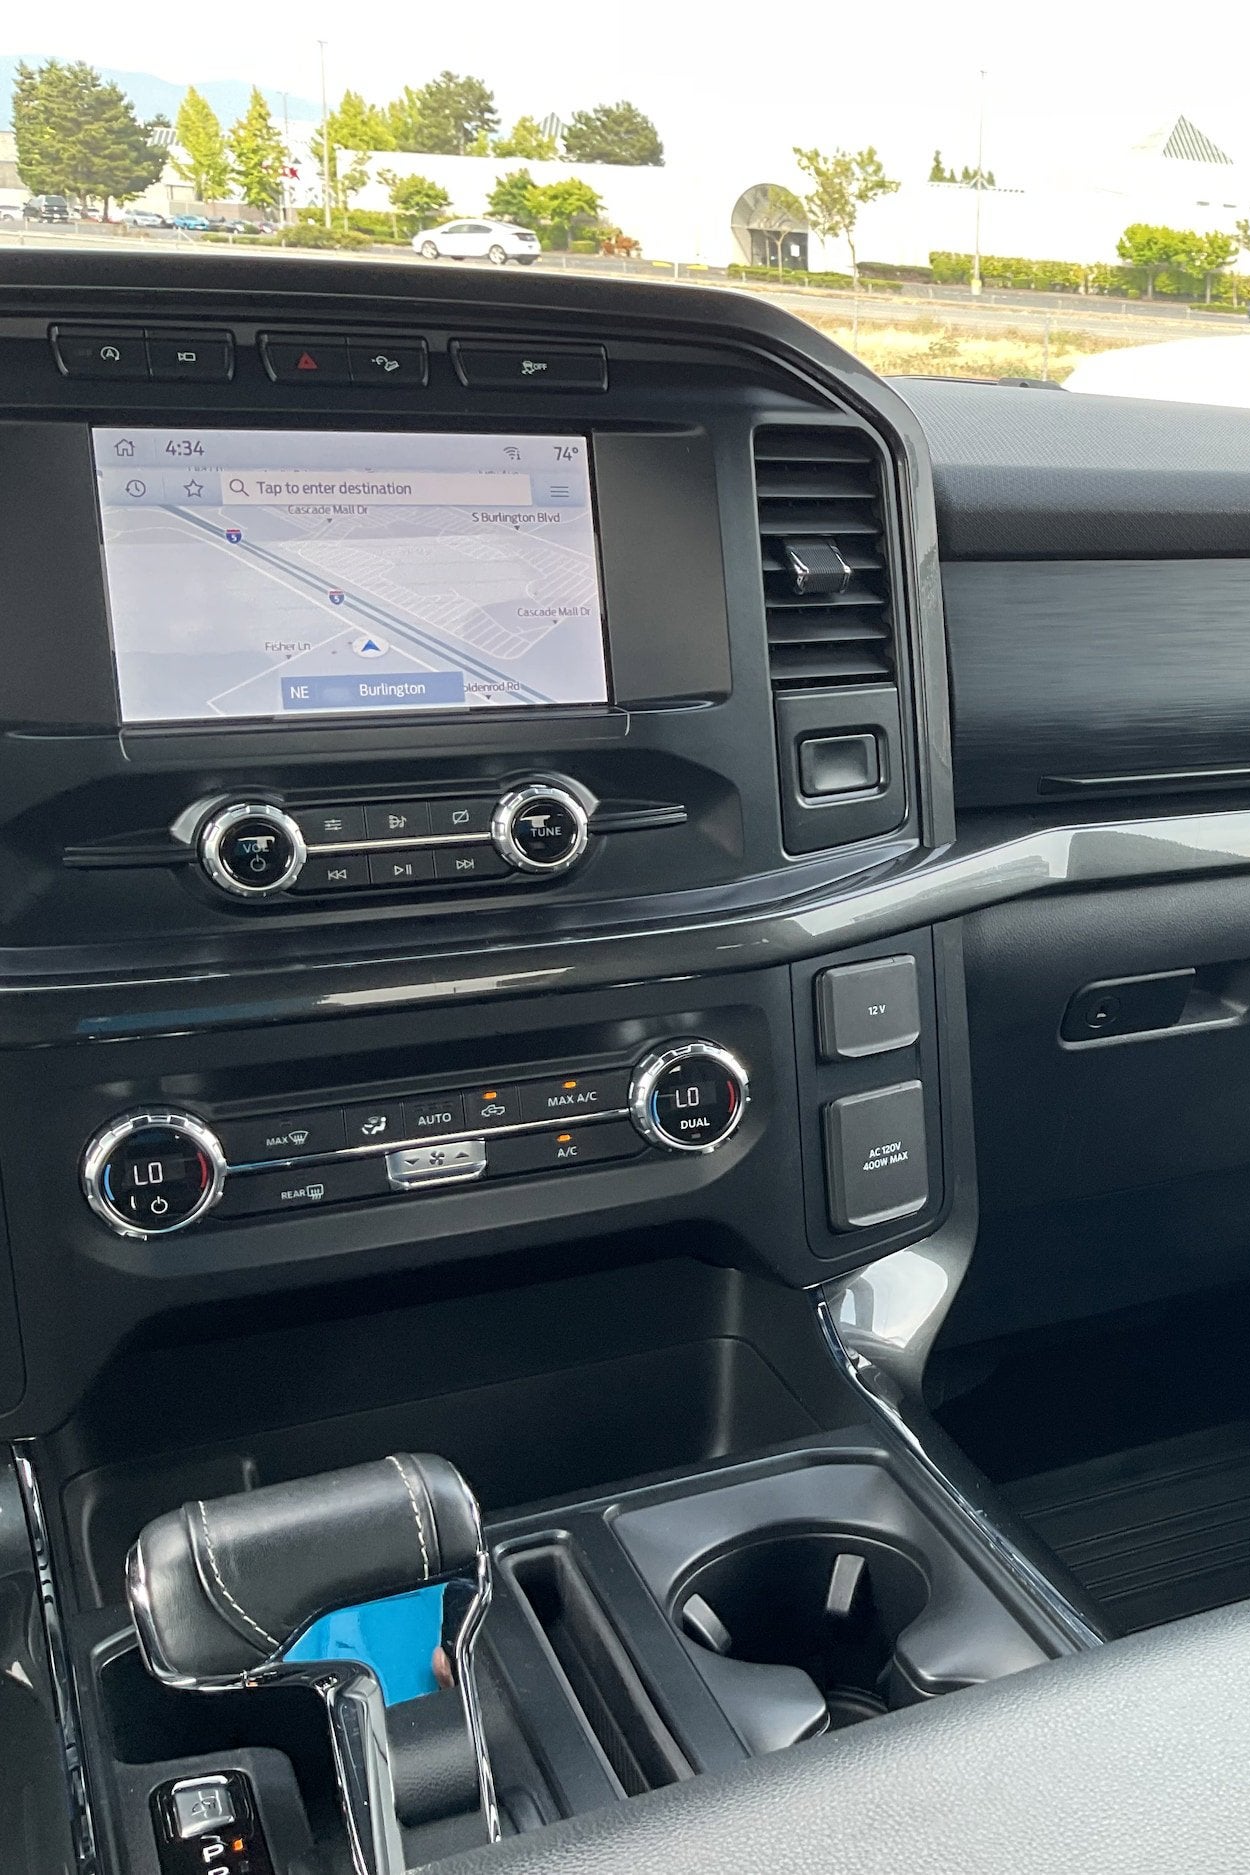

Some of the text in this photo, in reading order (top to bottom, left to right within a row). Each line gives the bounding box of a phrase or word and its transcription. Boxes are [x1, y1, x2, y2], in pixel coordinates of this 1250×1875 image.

[165, 440, 205, 457] 4:34
[553, 446, 580, 462] 74°
[256, 480, 412, 496] Tap to enter destination
[288, 505, 368, 515] Cascade Mall Dr
[472, 513, 561, 525] S Burlington Blvd
[517, 606, 591, 617] Cascade Mall Dr
[264, 641, 311, 651] Fisher Ln
[290, 682, 426, 699] NE Burlington
[463, 681, 520, 693] oldenrod Rd
[530, 827, 562, 837] TUNE
[242, 843, 270, 853] VOL
[868, 1004, 886, 1015] 12 V
[547, 1091, 598, 1107] MAX A/C
[675, 1086, 700, 1108] LO
[418, 1112, 452, 1126] AUTO
[680, 1117, 710, 1130] DUAL
[266, 1136, 289, 1146] MAX
[557, 1146, 578, 1158] A/C
[869, 1141, 901, 1158] AC 120V
[863, 1151, 909, 1170] 400W MAX
[133, 1161, 164, 1186] LO
[281, 1188, 307, 1200] REAR
[203, 1844, 225, 1863] P
